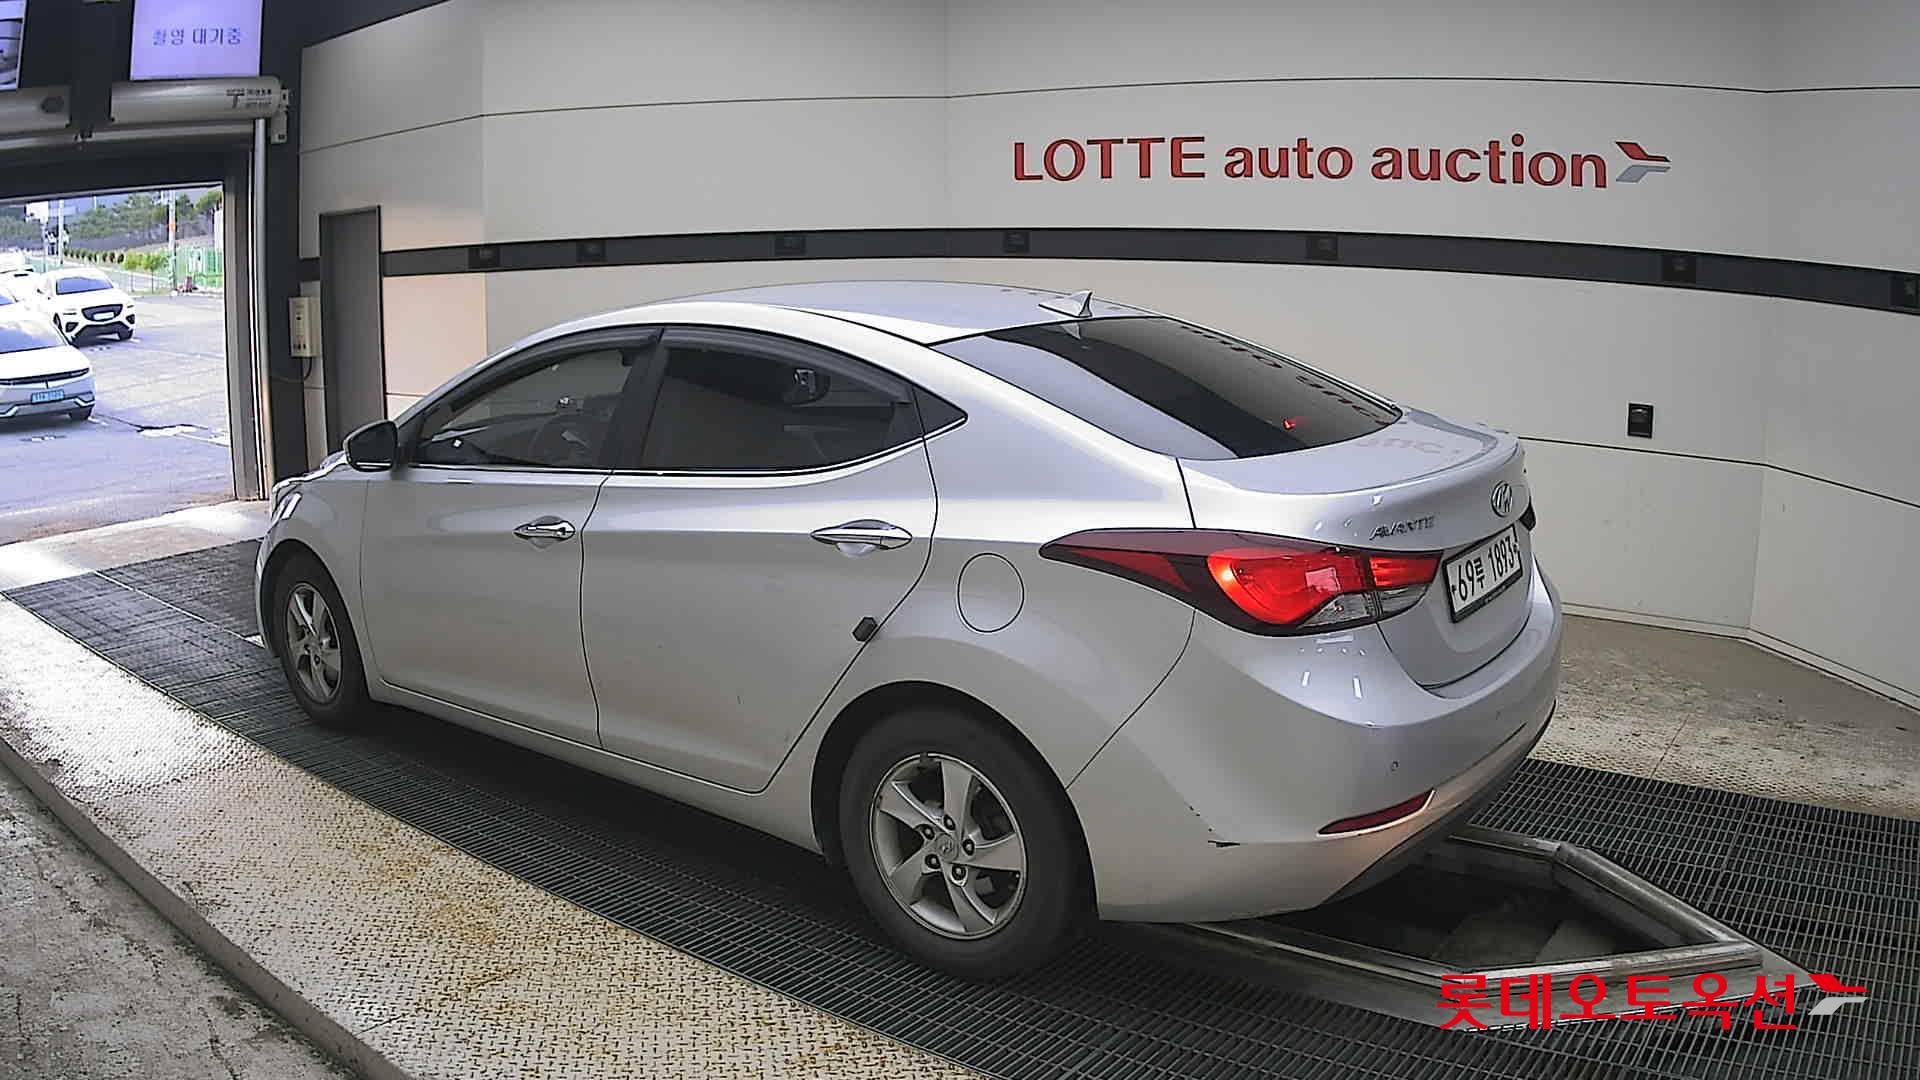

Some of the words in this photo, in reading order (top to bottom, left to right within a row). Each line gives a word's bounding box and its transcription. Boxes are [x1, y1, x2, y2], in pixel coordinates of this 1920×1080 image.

[192, 27, 241, 46] 대기중
[1013, 136, 1206, 181] LOTTE
[1224, 137, 1353, 179] auto
[1370, 133, 1608, 188] auction
[1457, 556, 1486, 602] 69루
[1487, 535, 1516, 582] 1893
